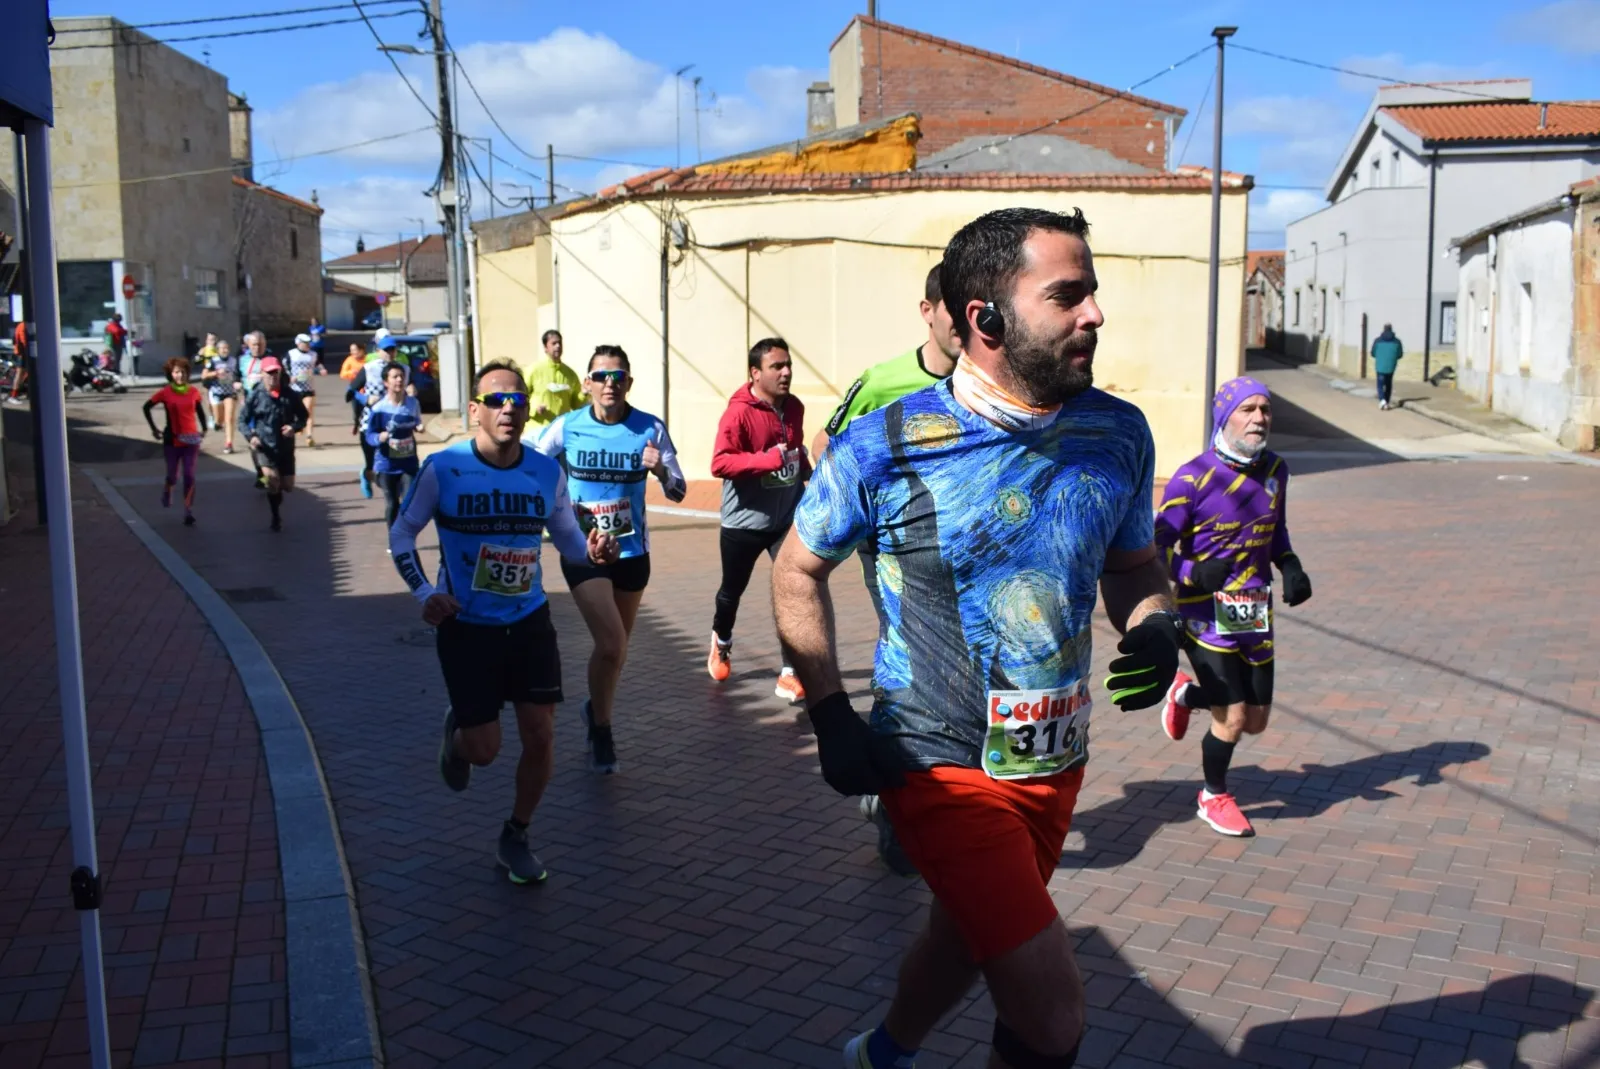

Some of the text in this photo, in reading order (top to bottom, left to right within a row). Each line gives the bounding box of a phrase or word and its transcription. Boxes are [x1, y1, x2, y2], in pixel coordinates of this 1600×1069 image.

[599, 472, 612, 480] de
[457, 488, 546, 517] naturé
[493, 520, 511, 532] de
[489, 563, 528, 585] 351
[1227, 603, 1257, 622] 333
[1010, 714, 1077, 756] 316
